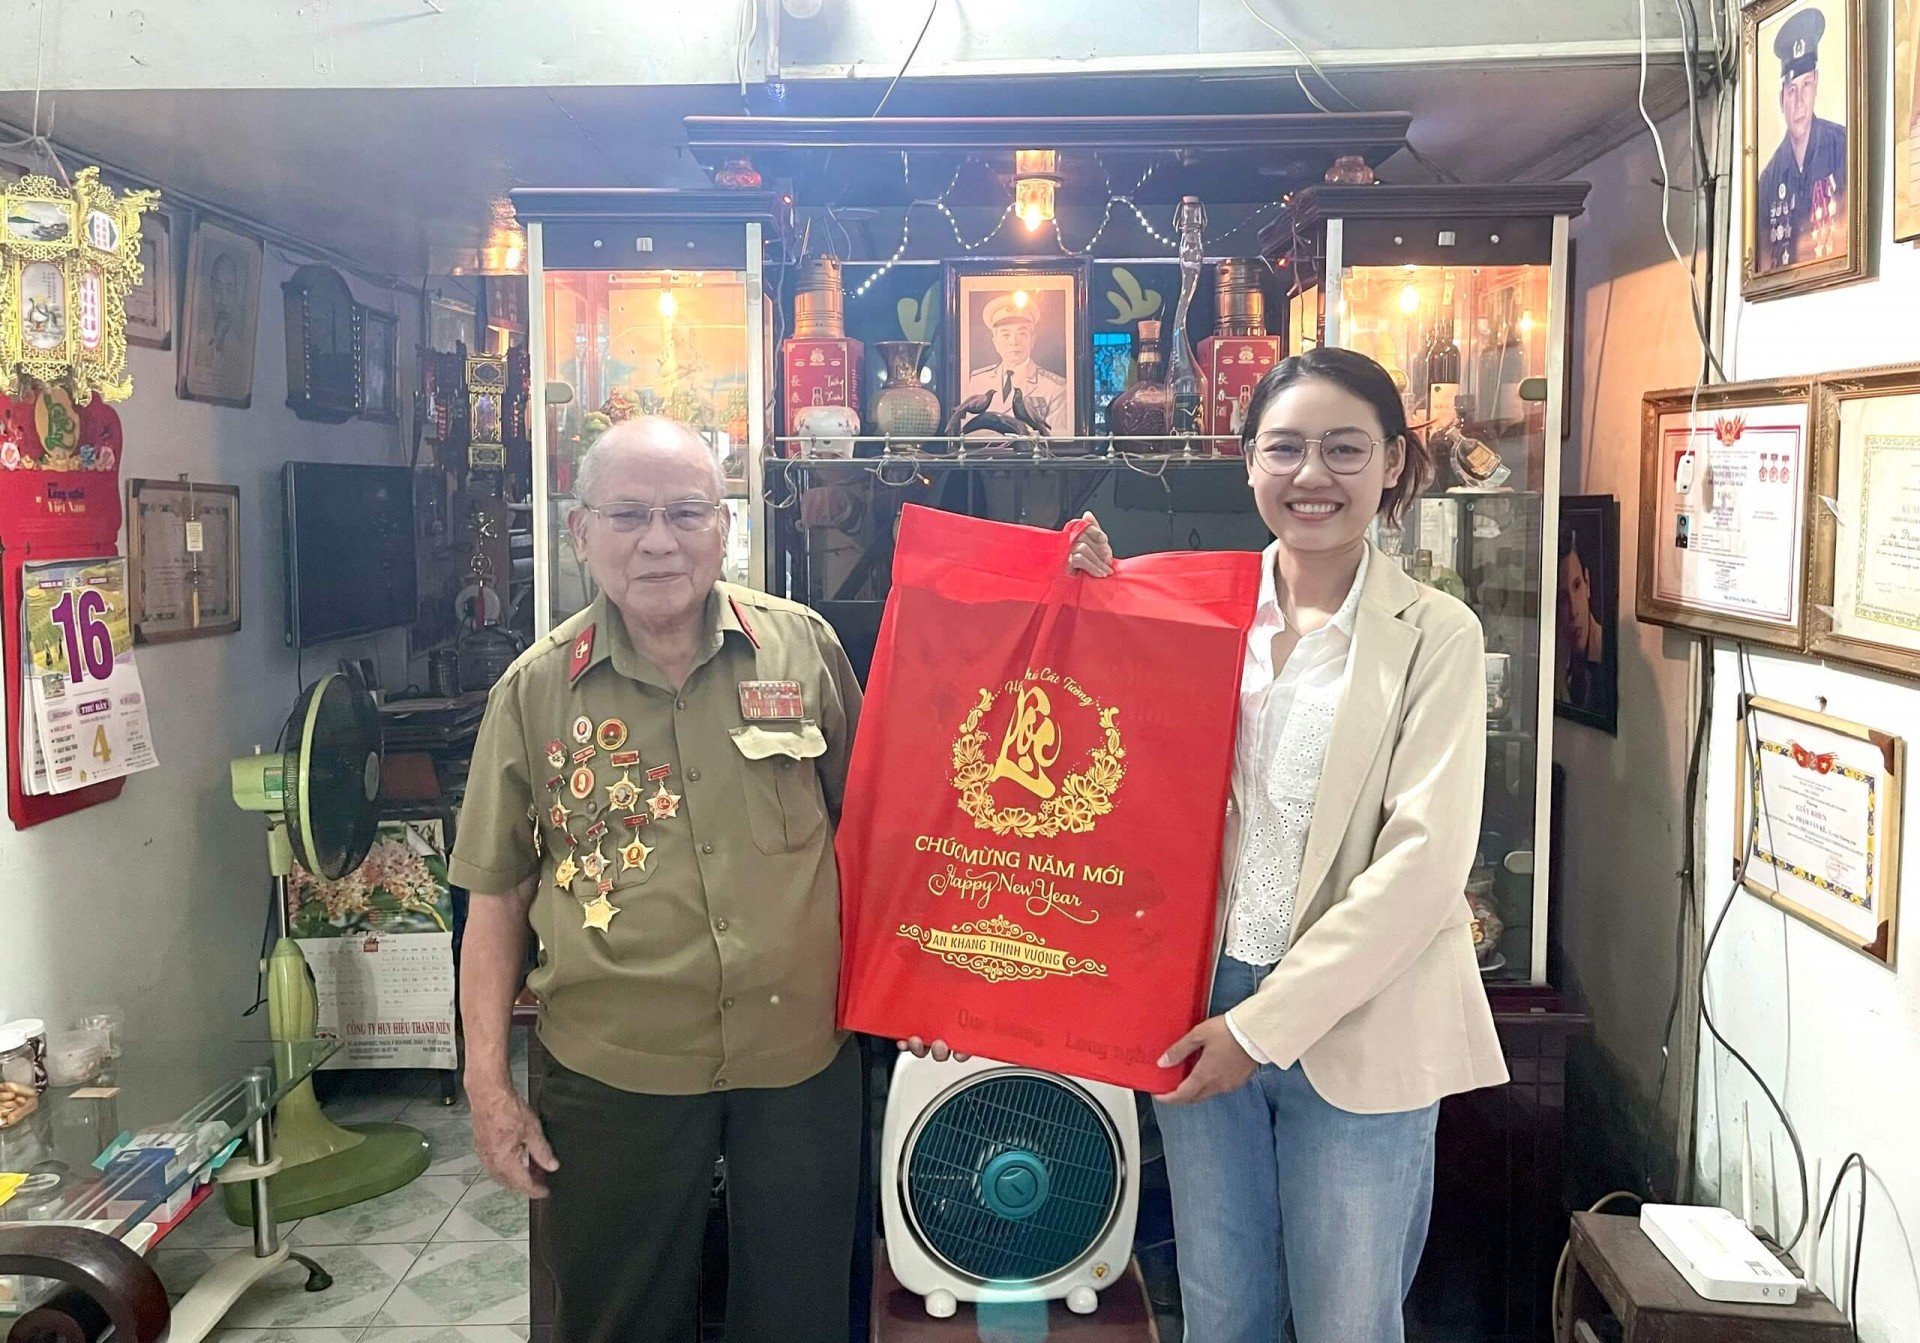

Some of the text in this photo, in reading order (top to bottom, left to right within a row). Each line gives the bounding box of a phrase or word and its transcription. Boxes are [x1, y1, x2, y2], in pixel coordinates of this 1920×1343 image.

[51, 589, 114, 684] 16
[1040, 667, 1060, 684] Cát
[92, 724, 111, 763] 4
[915, 835, 1125, 886] CHÚC MỪNG NĂM MỚI
[928, 864, 1099, 924] Happy New Year
[932, 934, 1061, 966] AN KHANG THỊNH VƯỢNG
[346, 1019, 451, 1037] CÔNG TY HUY HIỆU THANH NIÊN
